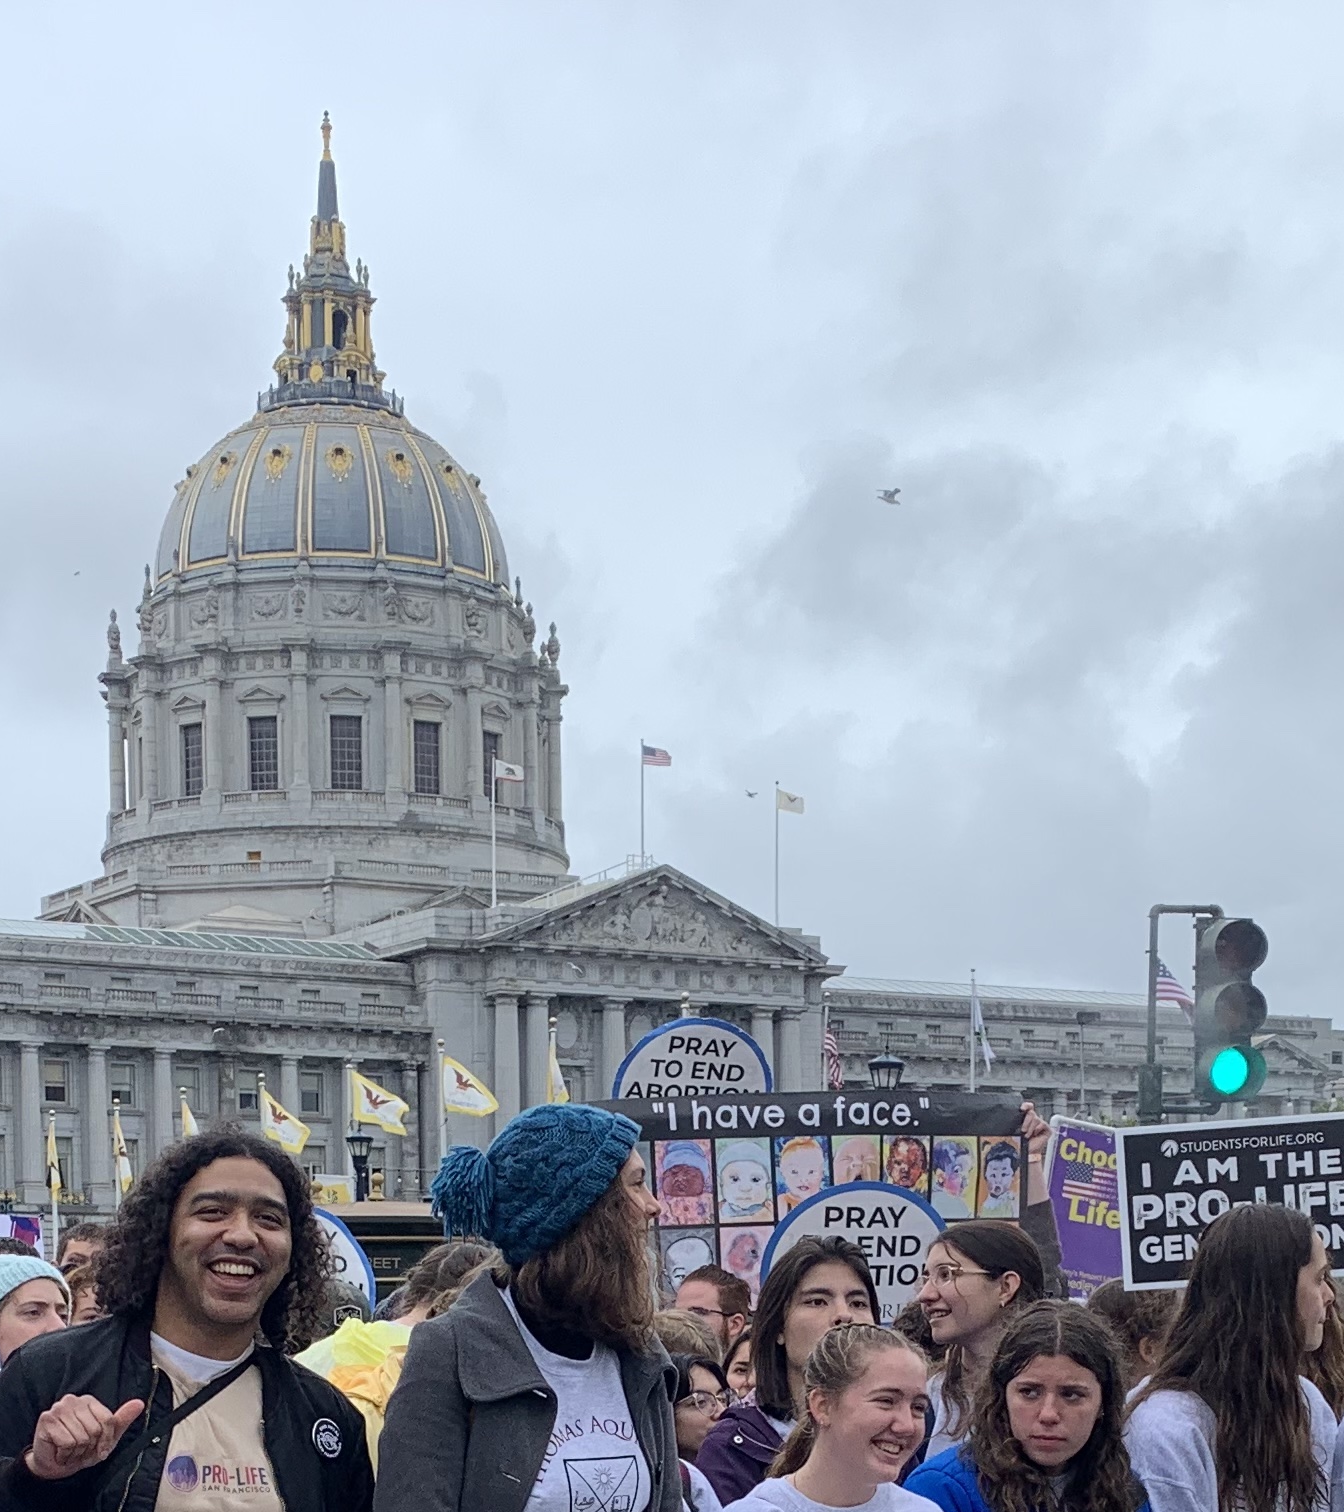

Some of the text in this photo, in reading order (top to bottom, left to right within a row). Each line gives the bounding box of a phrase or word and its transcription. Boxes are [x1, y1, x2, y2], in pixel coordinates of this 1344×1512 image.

[667, 1035, 738, 1059] PRAY
[650, 1058, 746, 1083] TO END
[624, 1081, 760, 1099] ABORTI
[691, 1099, 786, 1131] have
[798, 1102, 821, 1129] a
[1179, 1131, 1325, 1154] STUDENTSFORLIFE.ORG
[1141, 1148, 1343, 1188] I AM THE
[823, 1205, 908, 1229] PRAY
[1068, 1195, 1121, 1230] Life
[856, 1234, 921, 1258] END
[370, 1256, 402, 1270] EET
[535, 1418, 584, 1484] HOMAS
[201, 1464, 269, 1487] PRO-LIFE
